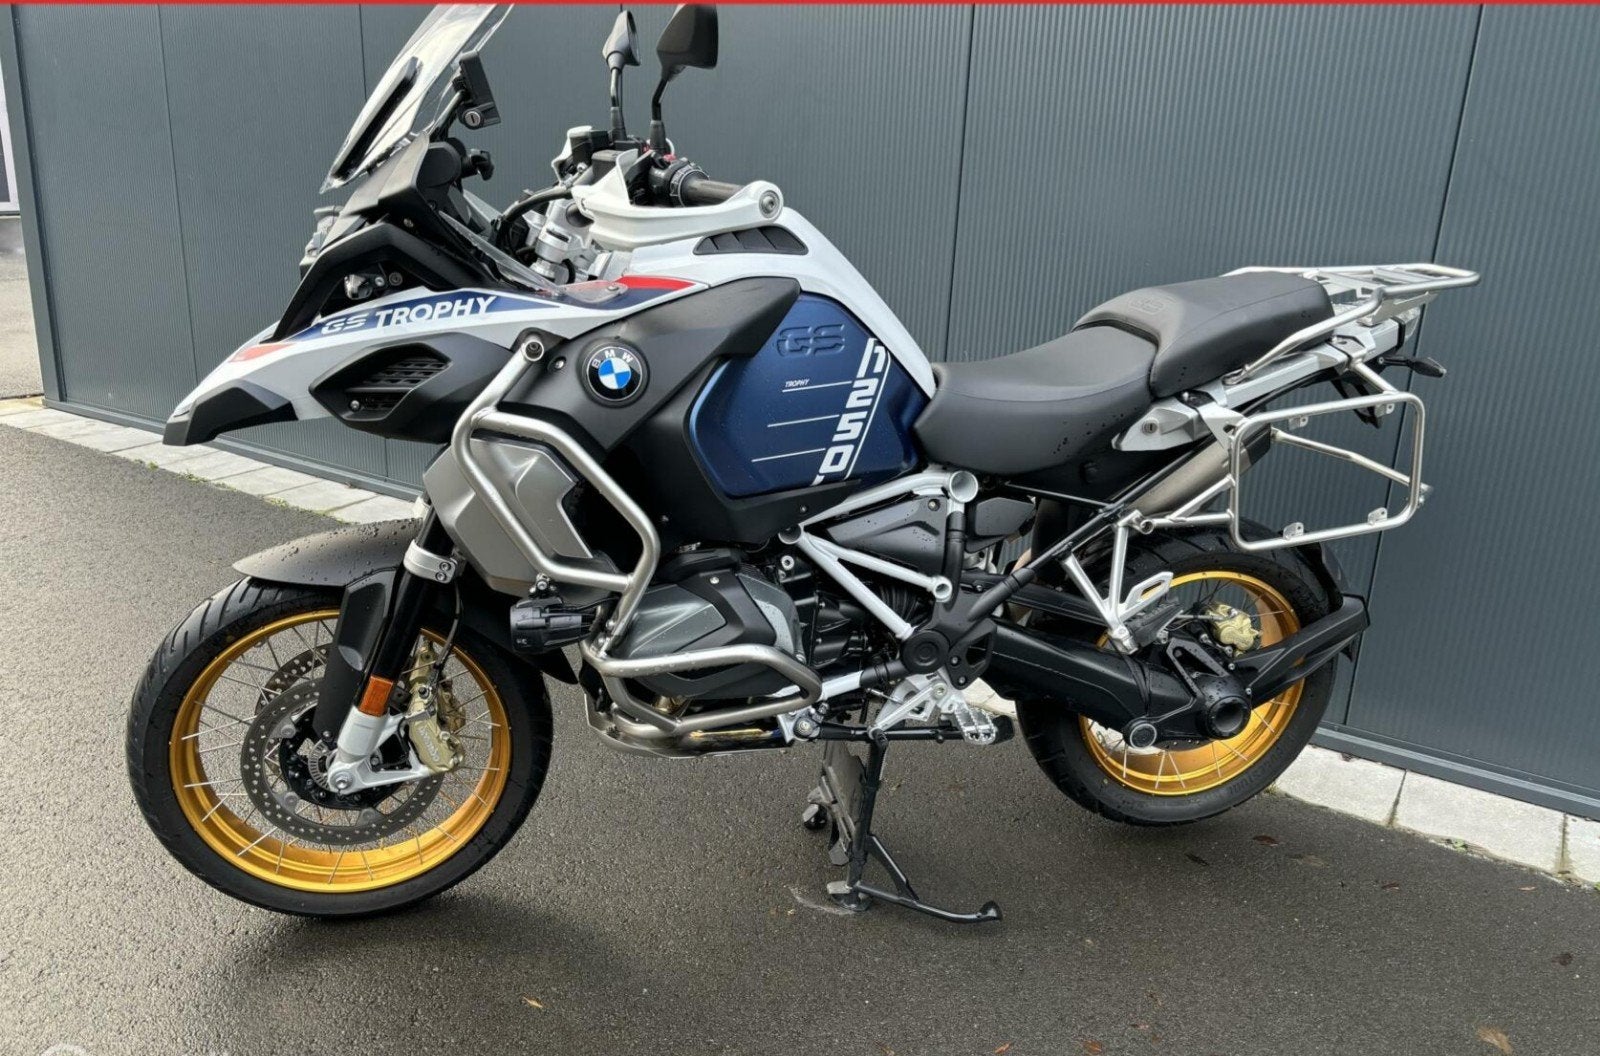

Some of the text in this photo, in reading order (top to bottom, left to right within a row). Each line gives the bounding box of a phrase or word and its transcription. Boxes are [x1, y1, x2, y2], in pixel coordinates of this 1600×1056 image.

[321, 295, 497, 335] GS TROPHY
[776, 322, 847, 357] GS
[591, 348, 634, 369] BMW
[785, 378, 810, 388] TROPHY
